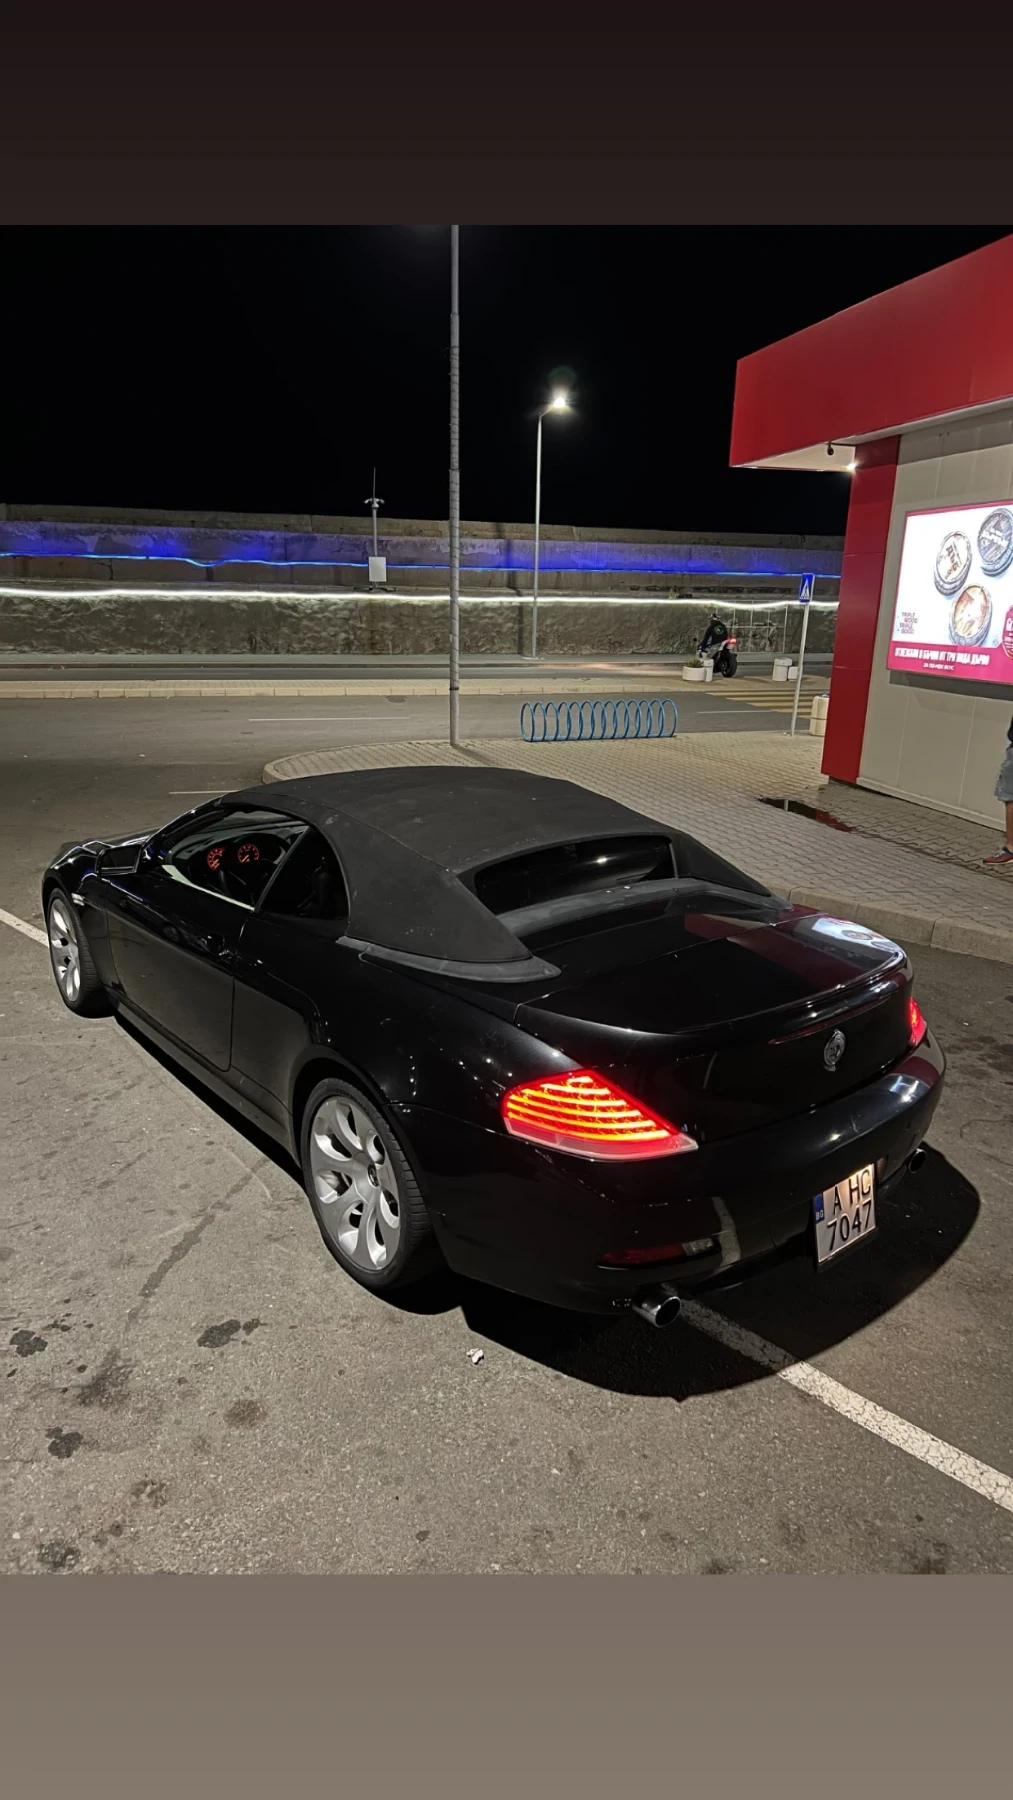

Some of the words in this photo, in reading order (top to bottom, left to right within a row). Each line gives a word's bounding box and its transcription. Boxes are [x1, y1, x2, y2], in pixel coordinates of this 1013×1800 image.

[815, 1209, 824, 1221] BG
[833, 1185, 842, 1215] A
[848, 1168, 871, 1206] HC
[826, 1198, 872, 1252] 7047
